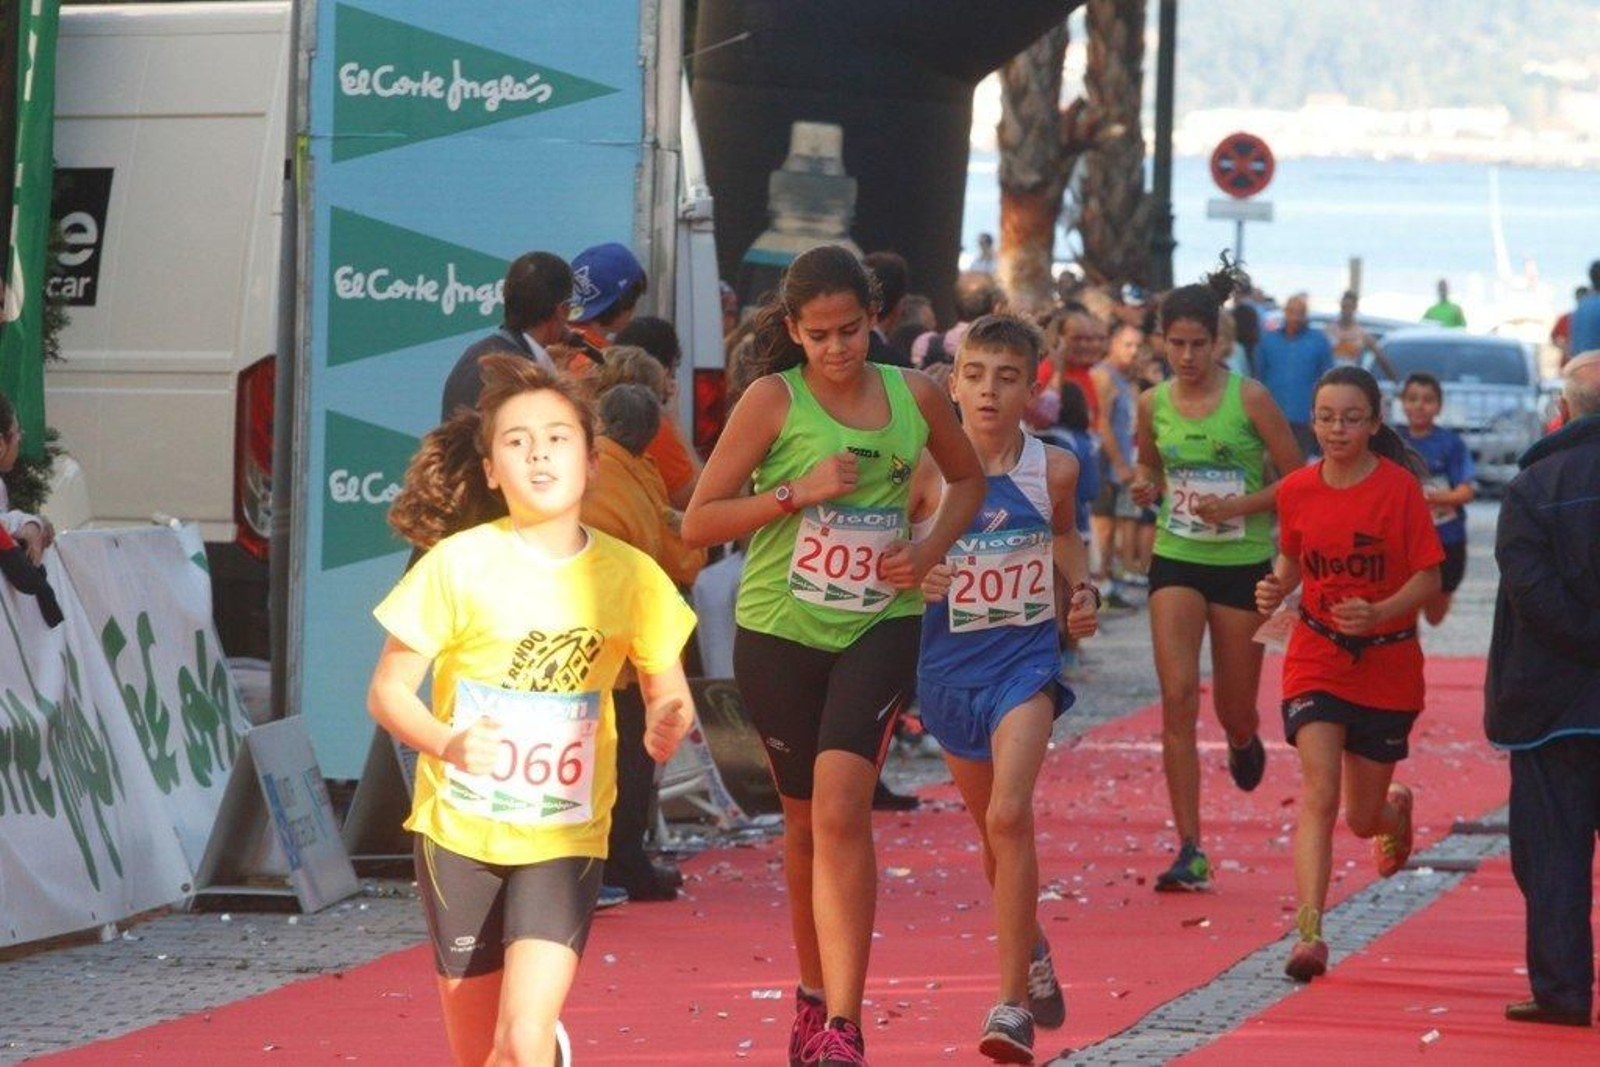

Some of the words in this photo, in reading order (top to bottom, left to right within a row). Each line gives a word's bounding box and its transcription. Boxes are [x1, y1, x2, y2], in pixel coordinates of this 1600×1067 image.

[338, 62, 370, 96] El
[372, 65, 444, 98] Corte
[446, 59, 552, 111] Inglés
[334, 266, 366, 299] El
[366, 268, 440, 302] Corte
[329, 469, 360, 502] El
[955, 560, 1046, 603] 2072
[490, 739, 583, 786] 066
